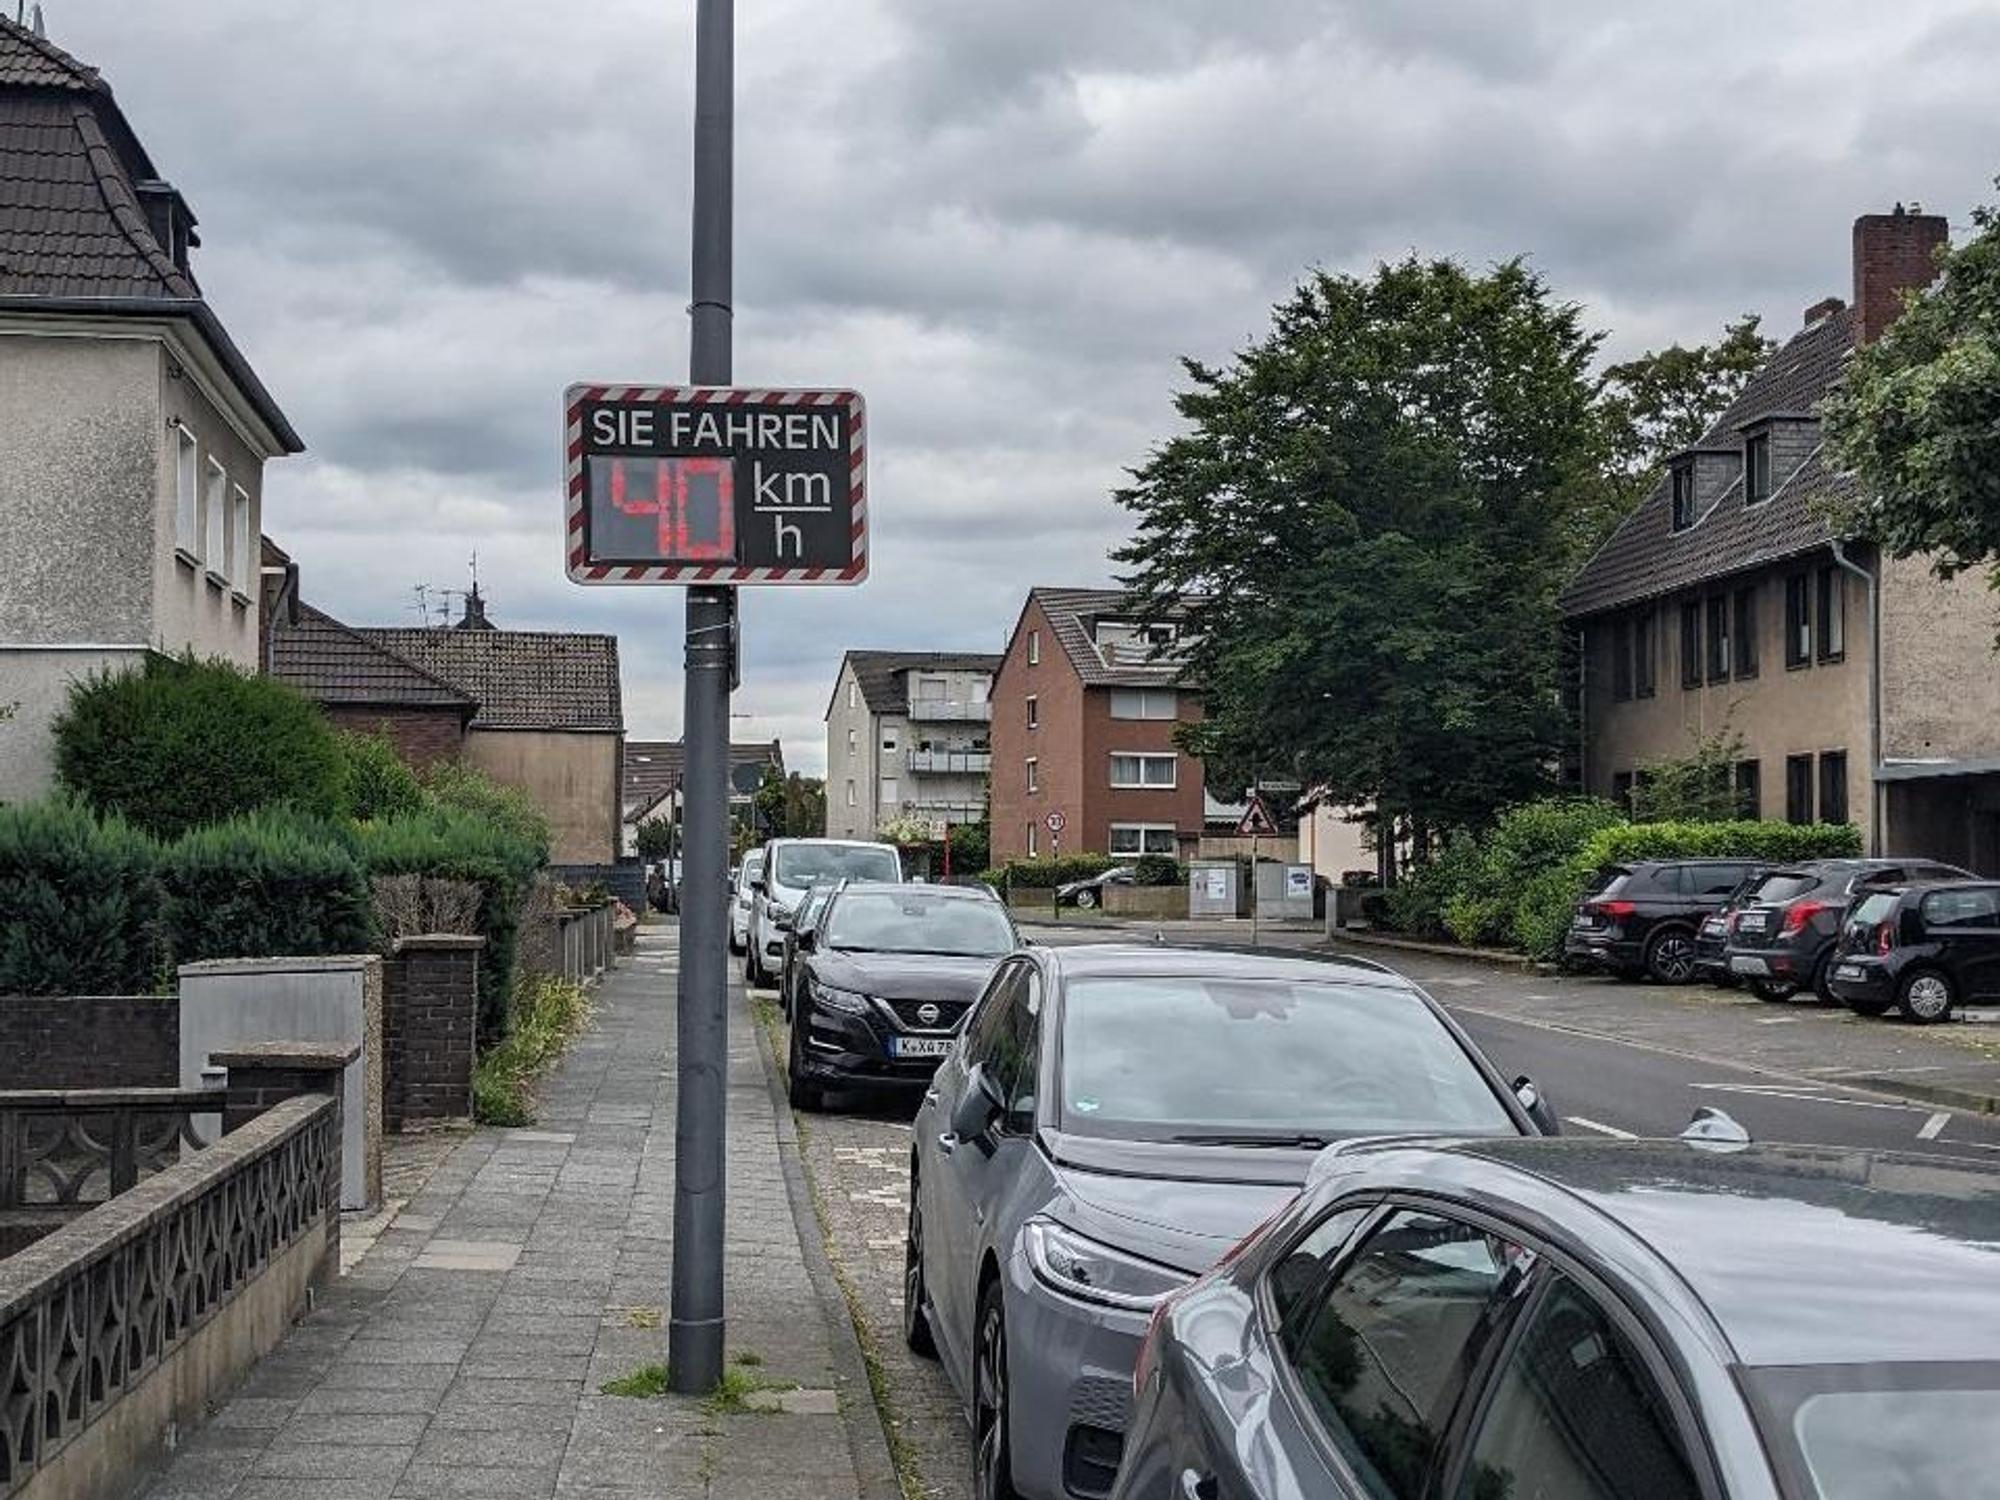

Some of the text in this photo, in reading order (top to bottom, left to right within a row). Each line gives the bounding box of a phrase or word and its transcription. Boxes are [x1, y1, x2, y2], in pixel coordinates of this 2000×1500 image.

[592, 409, 839, 450] SIE FAHREN
[754, 460, 831, 504] km
[611, 457, 734, 559] 40
[775, 514, 801, 557] h
